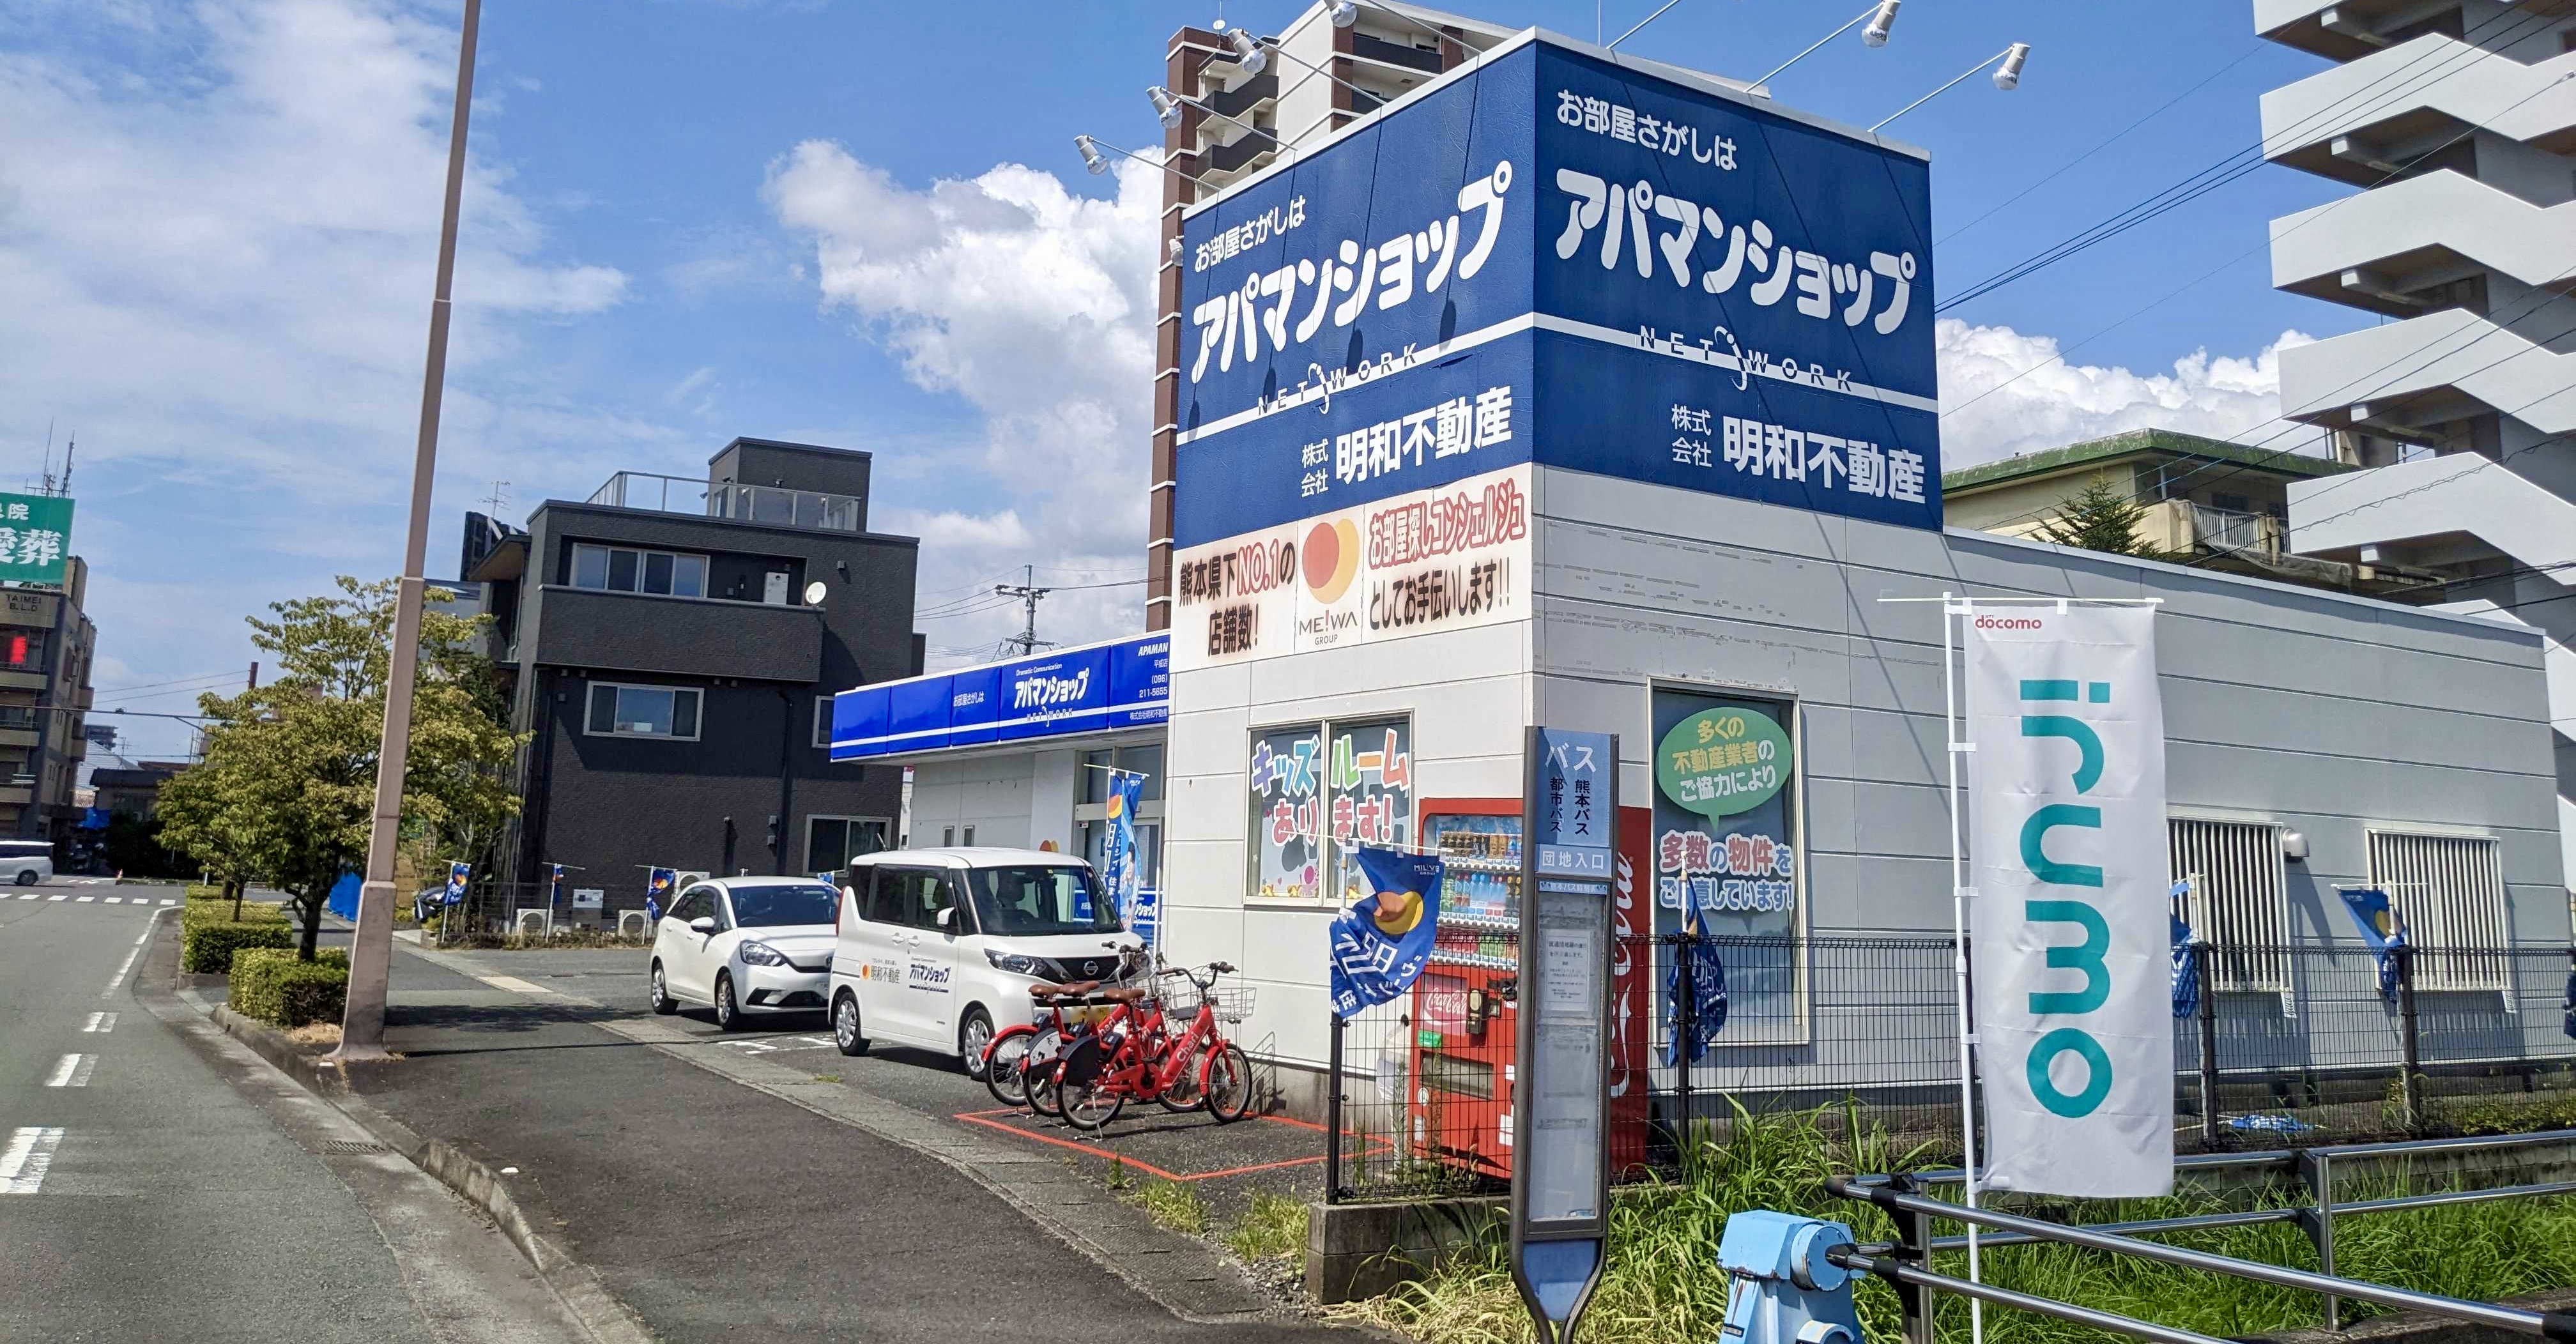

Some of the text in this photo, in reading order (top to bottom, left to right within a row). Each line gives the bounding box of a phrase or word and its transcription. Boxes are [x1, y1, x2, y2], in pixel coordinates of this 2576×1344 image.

[1557, 89, 1737, 171] お部屋さがしは
[1195, 195, 1306, 273] お部屋さがしは
[1556, 168, 1915, 334] アパマンショップ
[1192, 160, 1512, 383] アパマンショップ
[1336, 386, 1512, 485] 明和不動産
[1723, 415, 1925, 504] 明和不動産
[0, 503, 29, 521] 院
[1368, 477, 1526, 570] お部屋探しコンシェルジュ
[6, 594, 42, 604] TAIMEI
[1975, 615, 2043, 629] docomo
[1138, 642, 1169, 657] APAMAN
[1315, 634, 1338, 645] GROUP
[1034, 662, 1062, 673] Communication
[1151, 673, 1168, 684] (096)
[953, 691, 985, 707] お部屋さがしは
[1014, 667, 1089, 709] アパマンショップ
[1698, 717, 1744, 744] 多くの
[1545, 743, 1596, 773] バス
[1671, 739, 1774, 775] 不動産業者の
[1680, 765, 1776, 802] ご協力により
[1550, 777, 1563, 833] 都市バス
[1575, 779, 1590, 836] 熊本バス
[1542, 851, 1604, 869] 団地入口
[1661, 832, 1792, 875] 多数の物件を
[1661, 878, 1793, 910] ご意しています!
[2020, 679, 2112, 1119] irumo
[909, 963, 951, 983] アパマンショップ
[1097, 1016, 1117, 1041] hari
